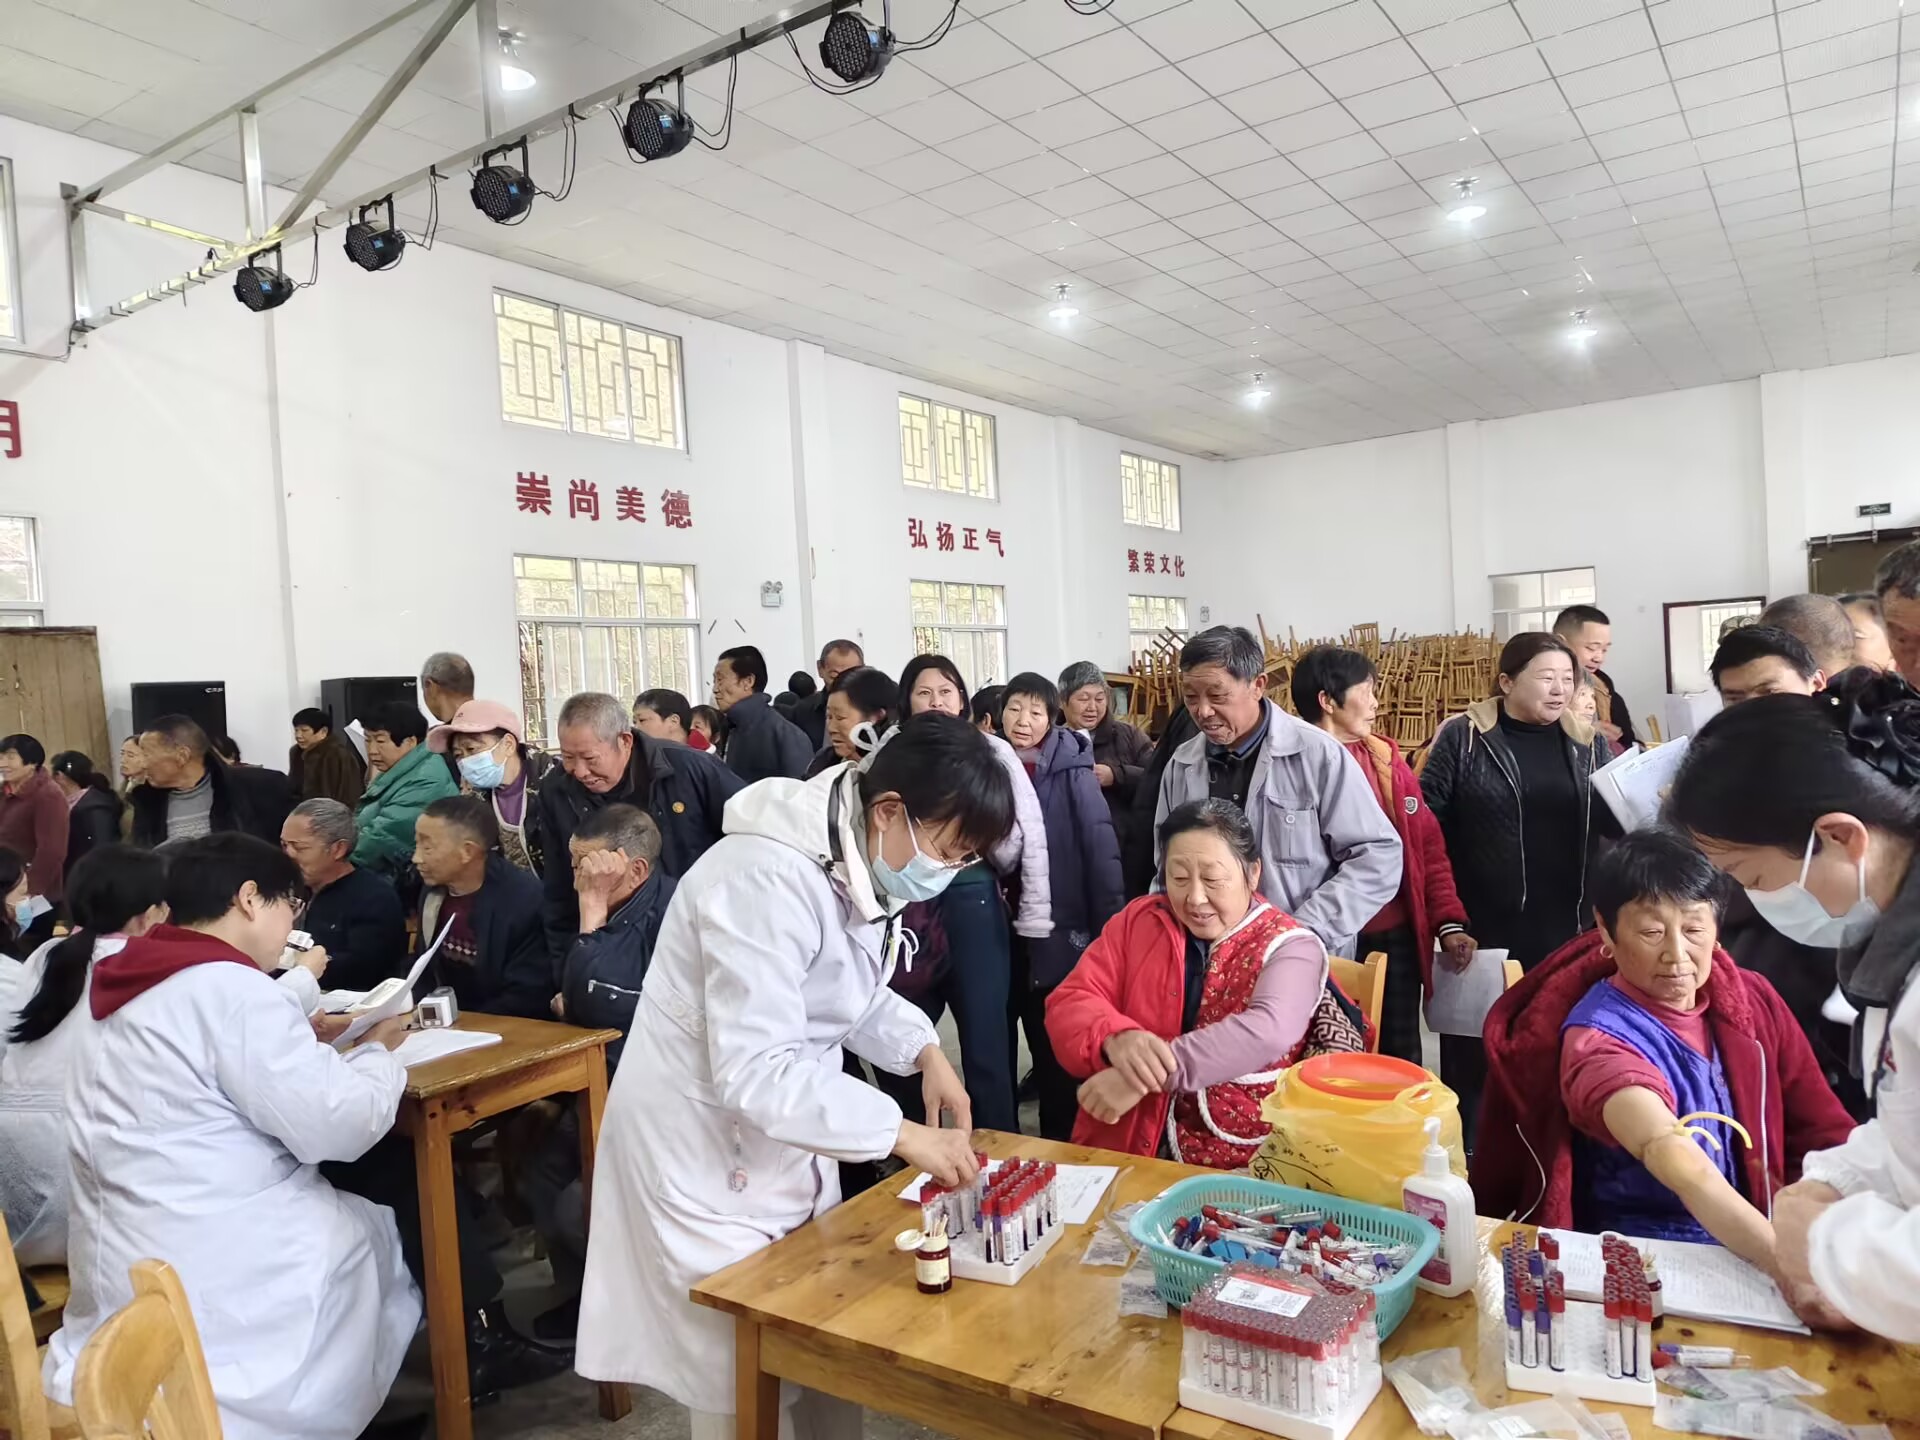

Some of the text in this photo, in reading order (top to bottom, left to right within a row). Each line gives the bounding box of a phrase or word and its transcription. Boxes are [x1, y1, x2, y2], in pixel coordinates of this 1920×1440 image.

[516, 471, 693, 529] 崇尚美德
[908, 518, 1004, 557] 弘扬正气
[1127, 549, 1186, 578] 繁荣文化
